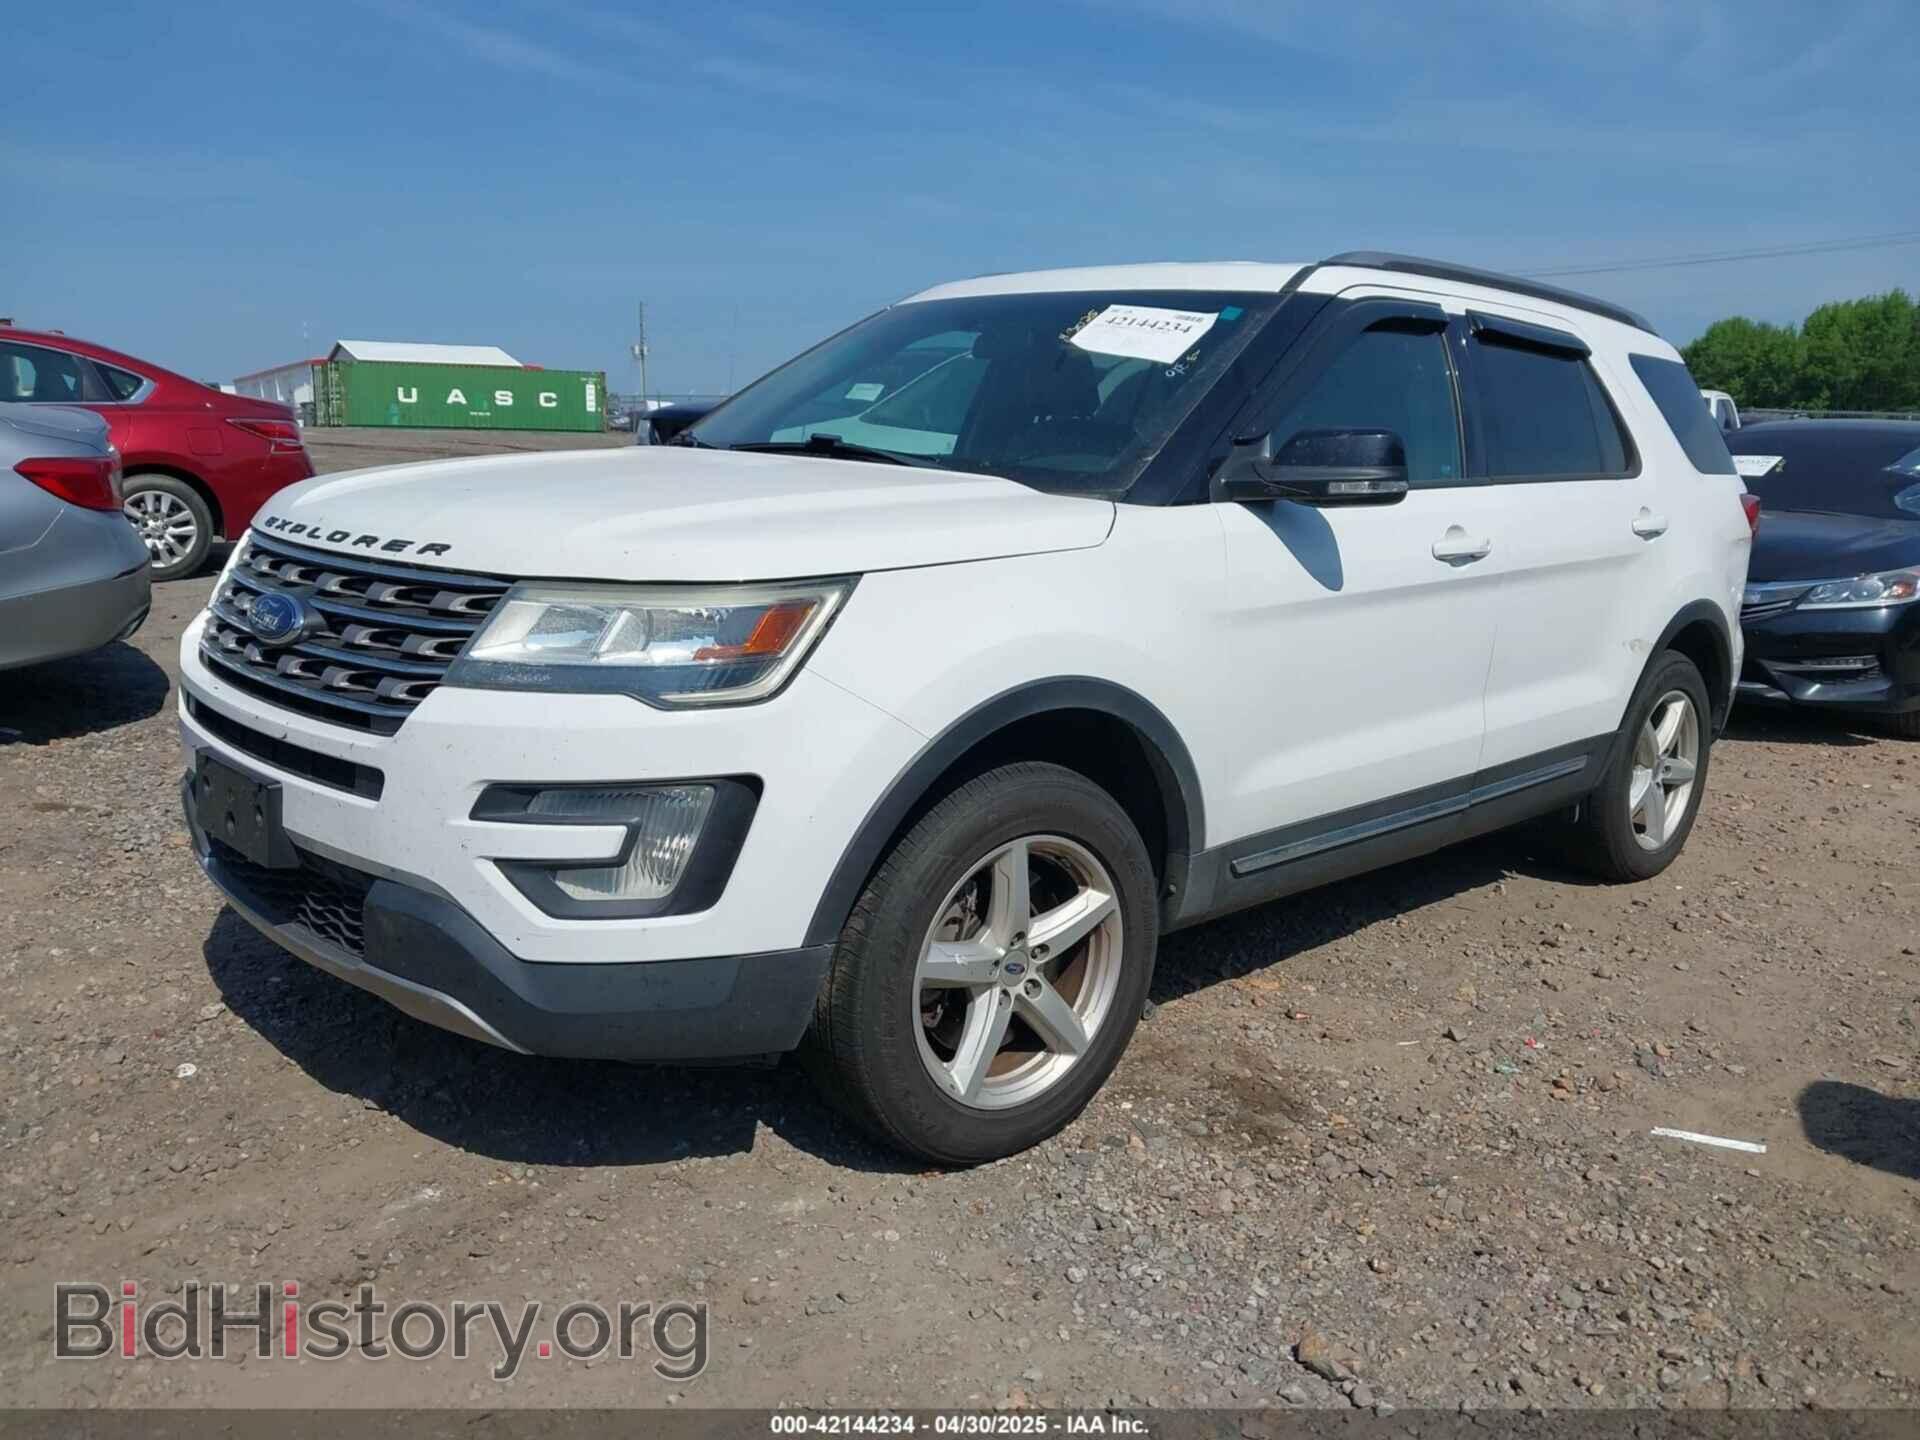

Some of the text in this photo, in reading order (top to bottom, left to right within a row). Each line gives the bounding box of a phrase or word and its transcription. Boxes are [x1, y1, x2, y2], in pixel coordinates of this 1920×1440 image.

[1105, 316, 1193, 334] 42144234
[397, 387, 558, 407] UASC
[264, 516, 452, 557] EXPLORER
